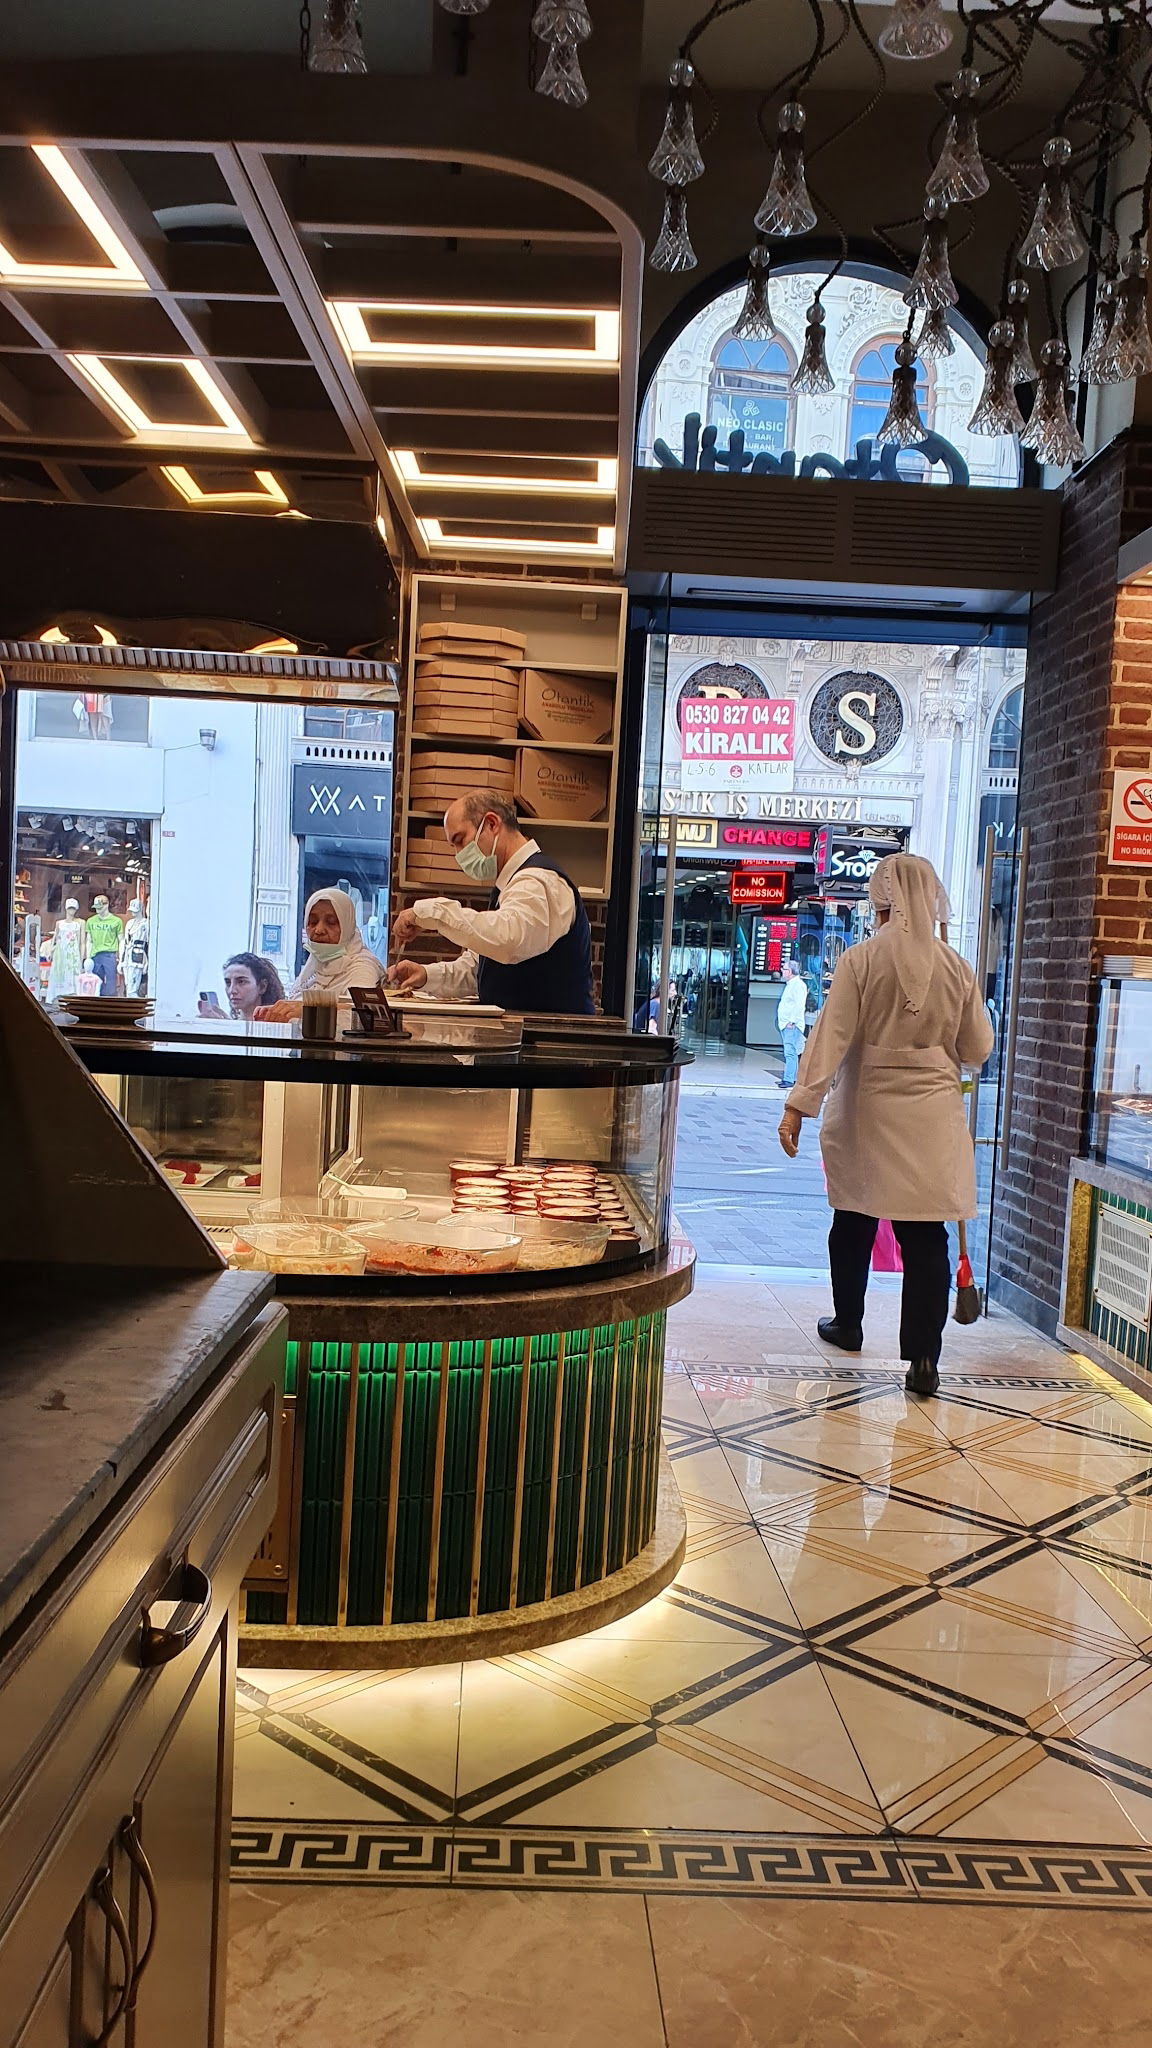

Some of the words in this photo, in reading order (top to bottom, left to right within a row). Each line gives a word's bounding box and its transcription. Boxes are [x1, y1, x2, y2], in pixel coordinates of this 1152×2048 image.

[744, 419, 784, 432] CLASIC
[541, 687, 595, 709] Otantik
[686, 705, 719, 724] 0530
[723, 705, 749, 725] 827
[752, 706, 769, 725] 04
[773, 706, 790, 725] 42
[834, 691, 877, 755] S
[685, 727, 789, 755] KİRALIK
[537, 767, 590, 785] Otantik
[748, 763, 788, 775] KATLAR
[726, 791, 749, 819] İŞ
[758, 795, 863, 822] MERKEZİ
[723, 826, 812, 848] CHANGE
[1116, 831, 1141, 841] SİGARA
[1121, 847, 1131, 855] NO
[751, 877, 765, 887] NO
[733, 888, 783, 898] COMISSION
